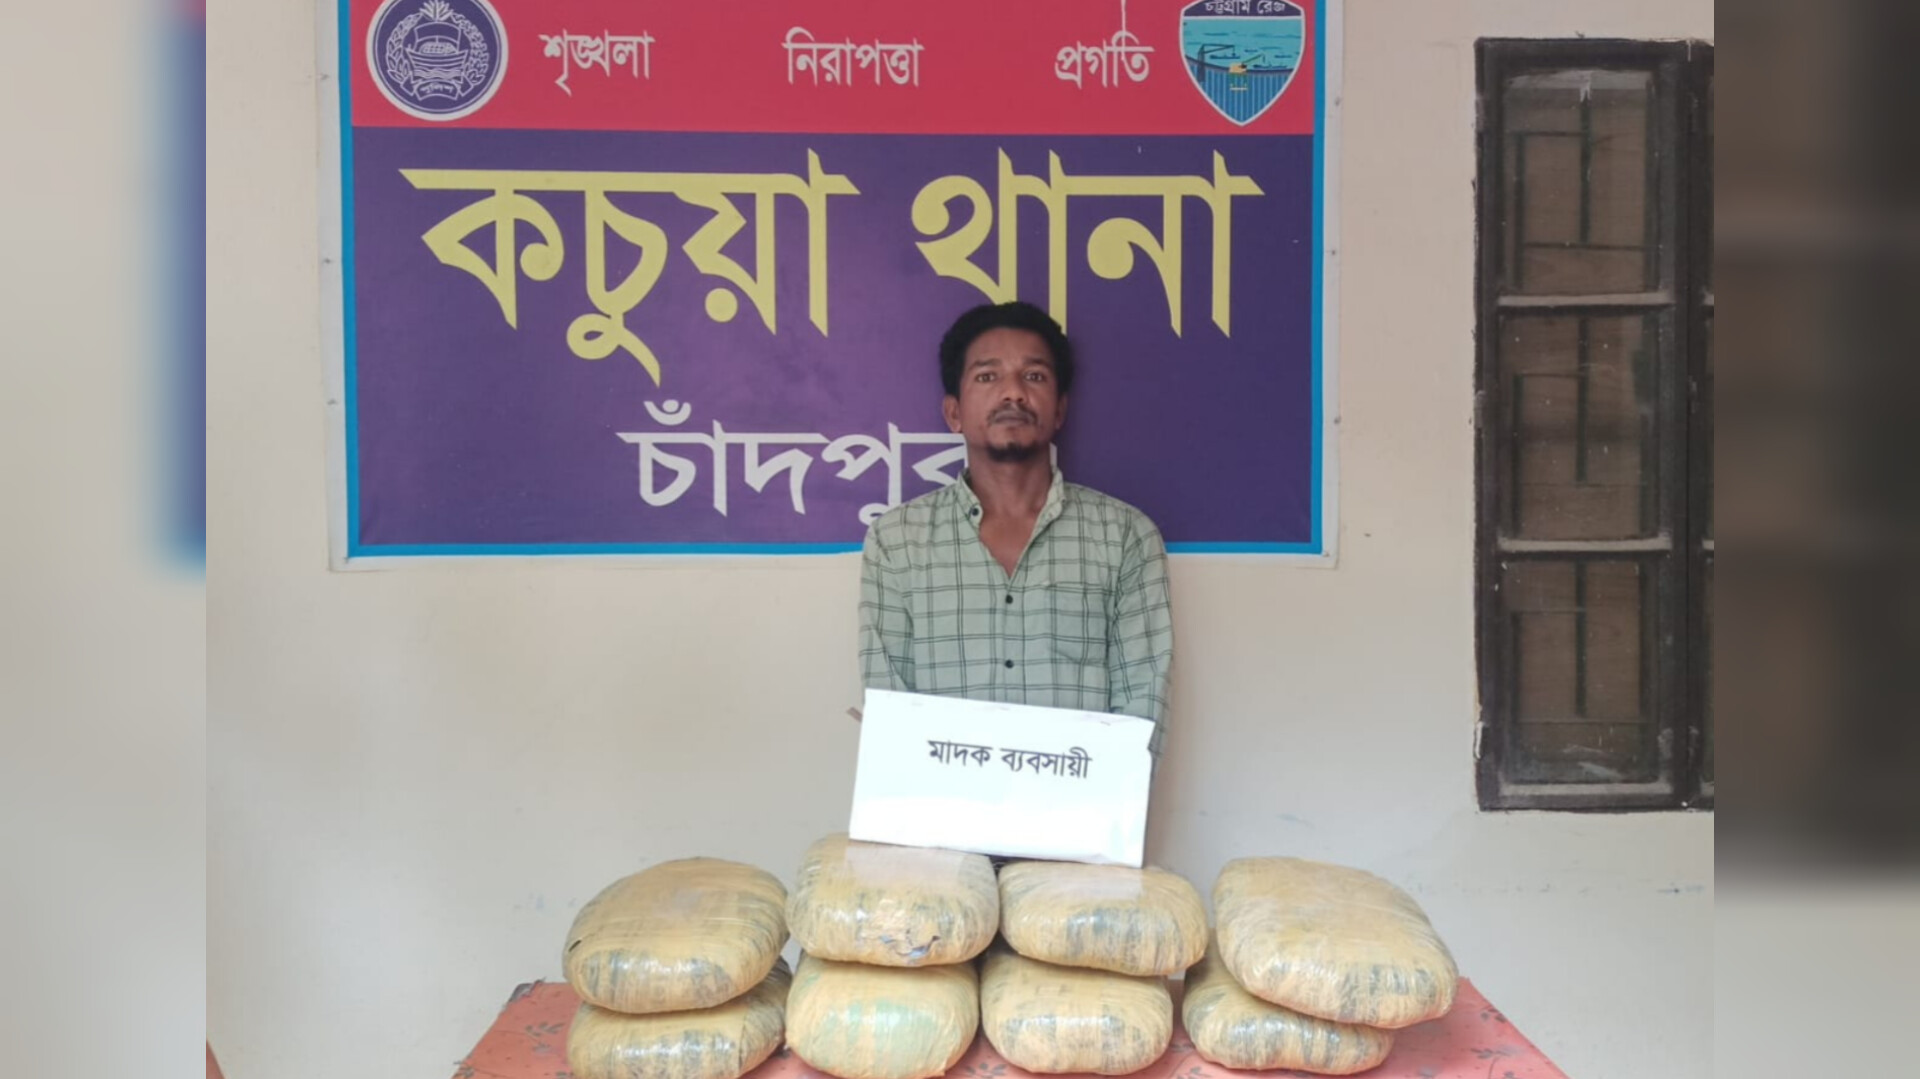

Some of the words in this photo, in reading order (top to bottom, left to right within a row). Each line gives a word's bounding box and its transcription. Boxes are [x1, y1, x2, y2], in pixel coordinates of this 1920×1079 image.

[538, 28, 656, 97] শৃঙ্খলা
[781, 26, 925, 87] নিরাপত্তা
[1054, 29, 1155, 89] প্রগতি
[399, 148, 860, 387] কচুয়া
[911, 148, 1265, 338] থানা
[927, 739, 993, 768] মাদক
[999, 746, 1093, 779] ব্যবসায়ী
